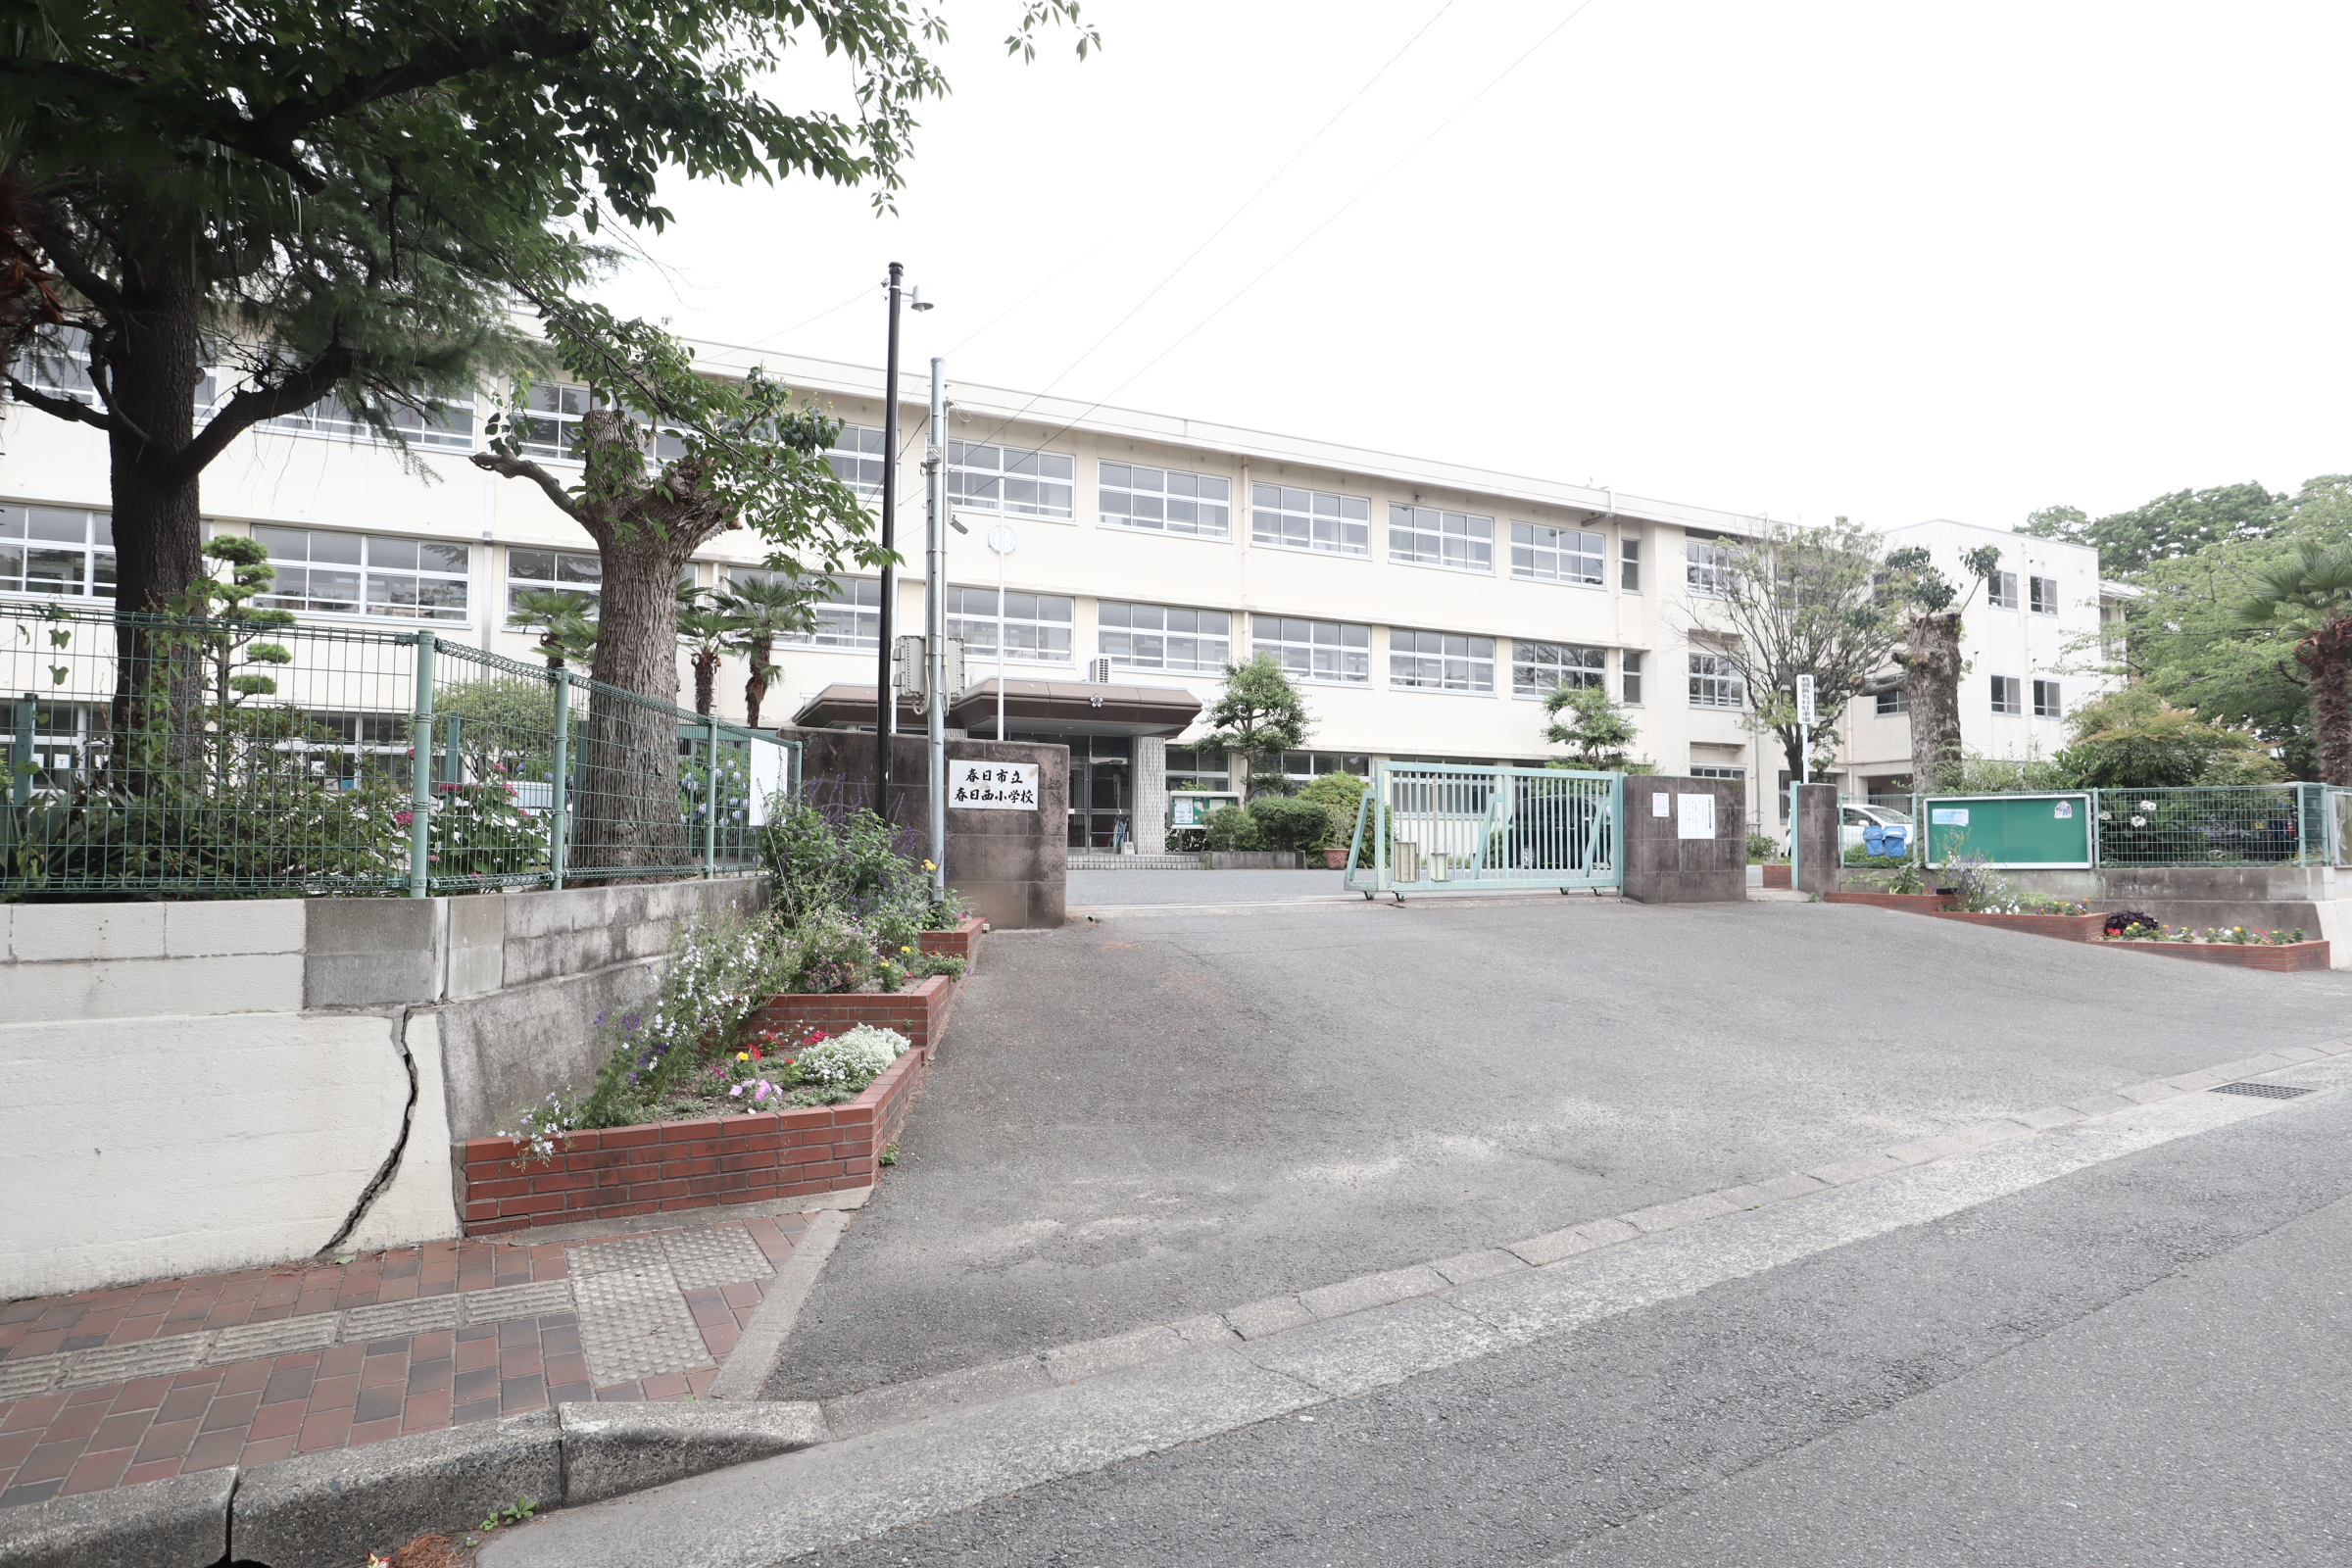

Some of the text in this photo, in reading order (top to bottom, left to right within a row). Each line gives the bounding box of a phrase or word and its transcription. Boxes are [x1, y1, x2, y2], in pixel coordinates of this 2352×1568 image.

[965, 767, 1023, 784] 春日市立
[955, 787, 1034, 804] 春日西小学校
